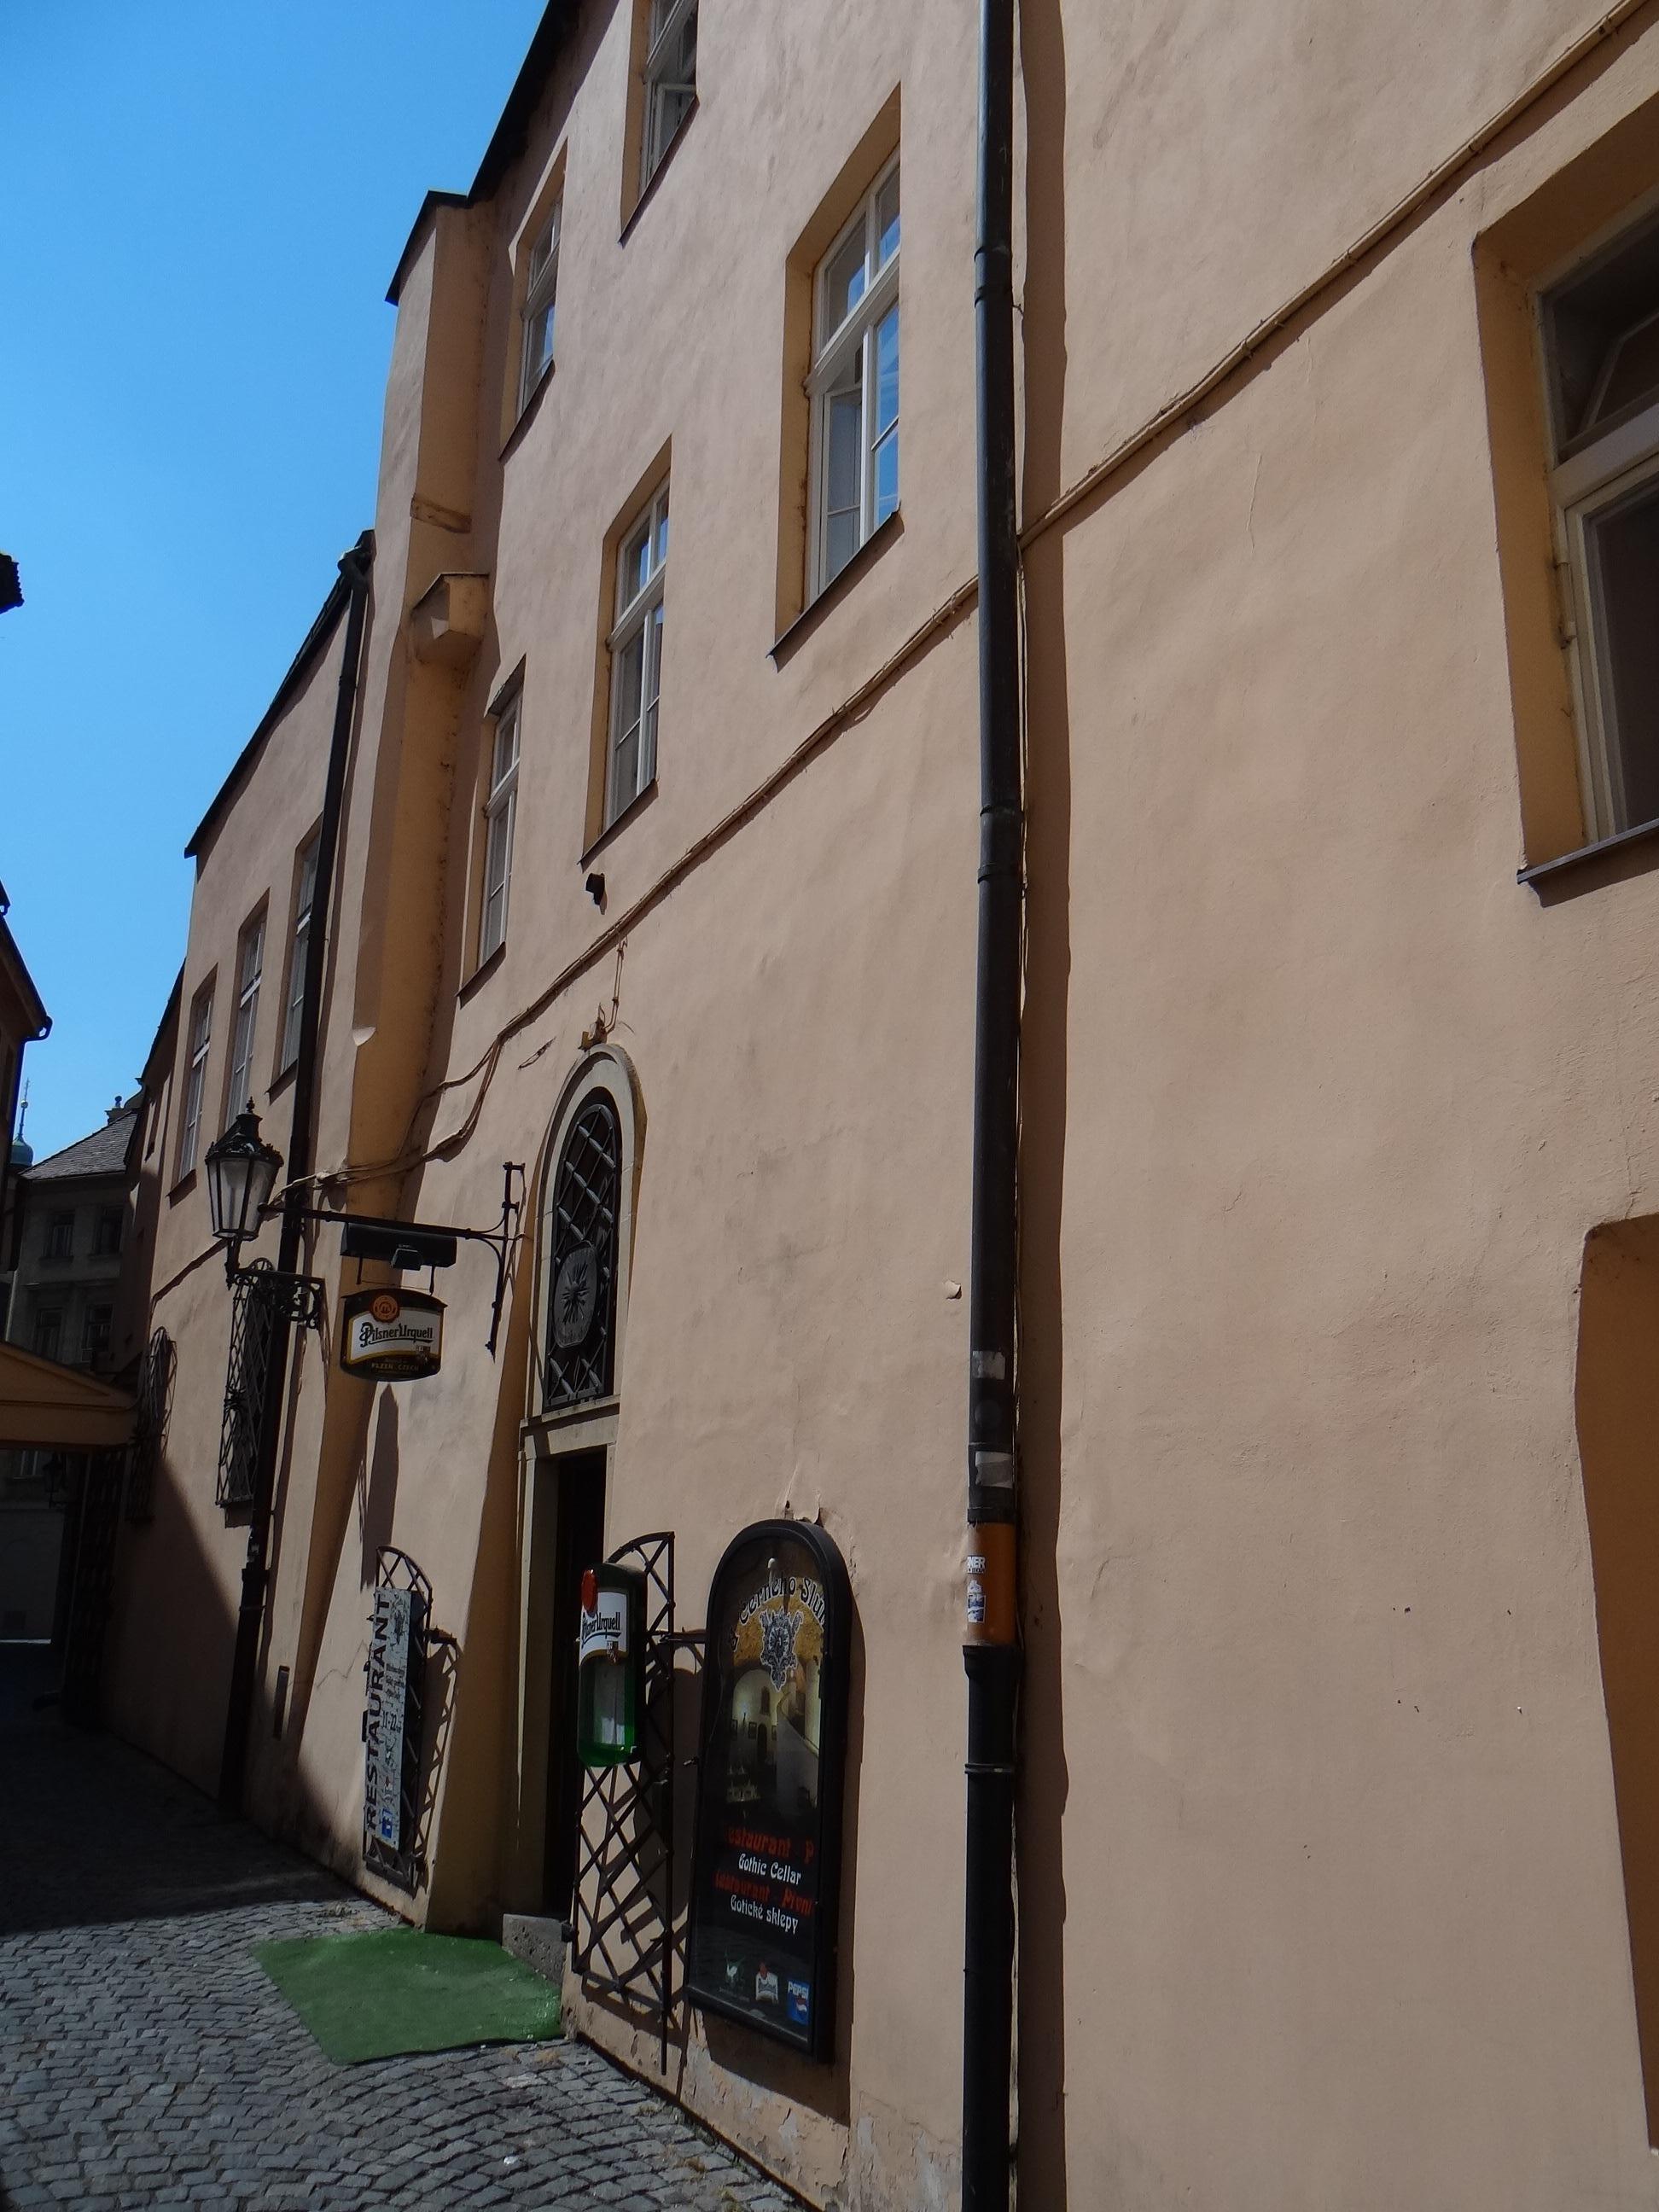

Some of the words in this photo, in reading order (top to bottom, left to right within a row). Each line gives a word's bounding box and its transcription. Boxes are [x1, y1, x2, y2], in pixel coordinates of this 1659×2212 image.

[366, 1594, 391, 1831] RESTAURANT
[738, 1853, 766, 1877] Gothic
[770, 1861, 801, 1885] Cellar
[731, 1895, 764, 1921] Gotické
[766, 1906, 799, 1935] sklepy
[787, 1980, 810, 2000] PEPSI
